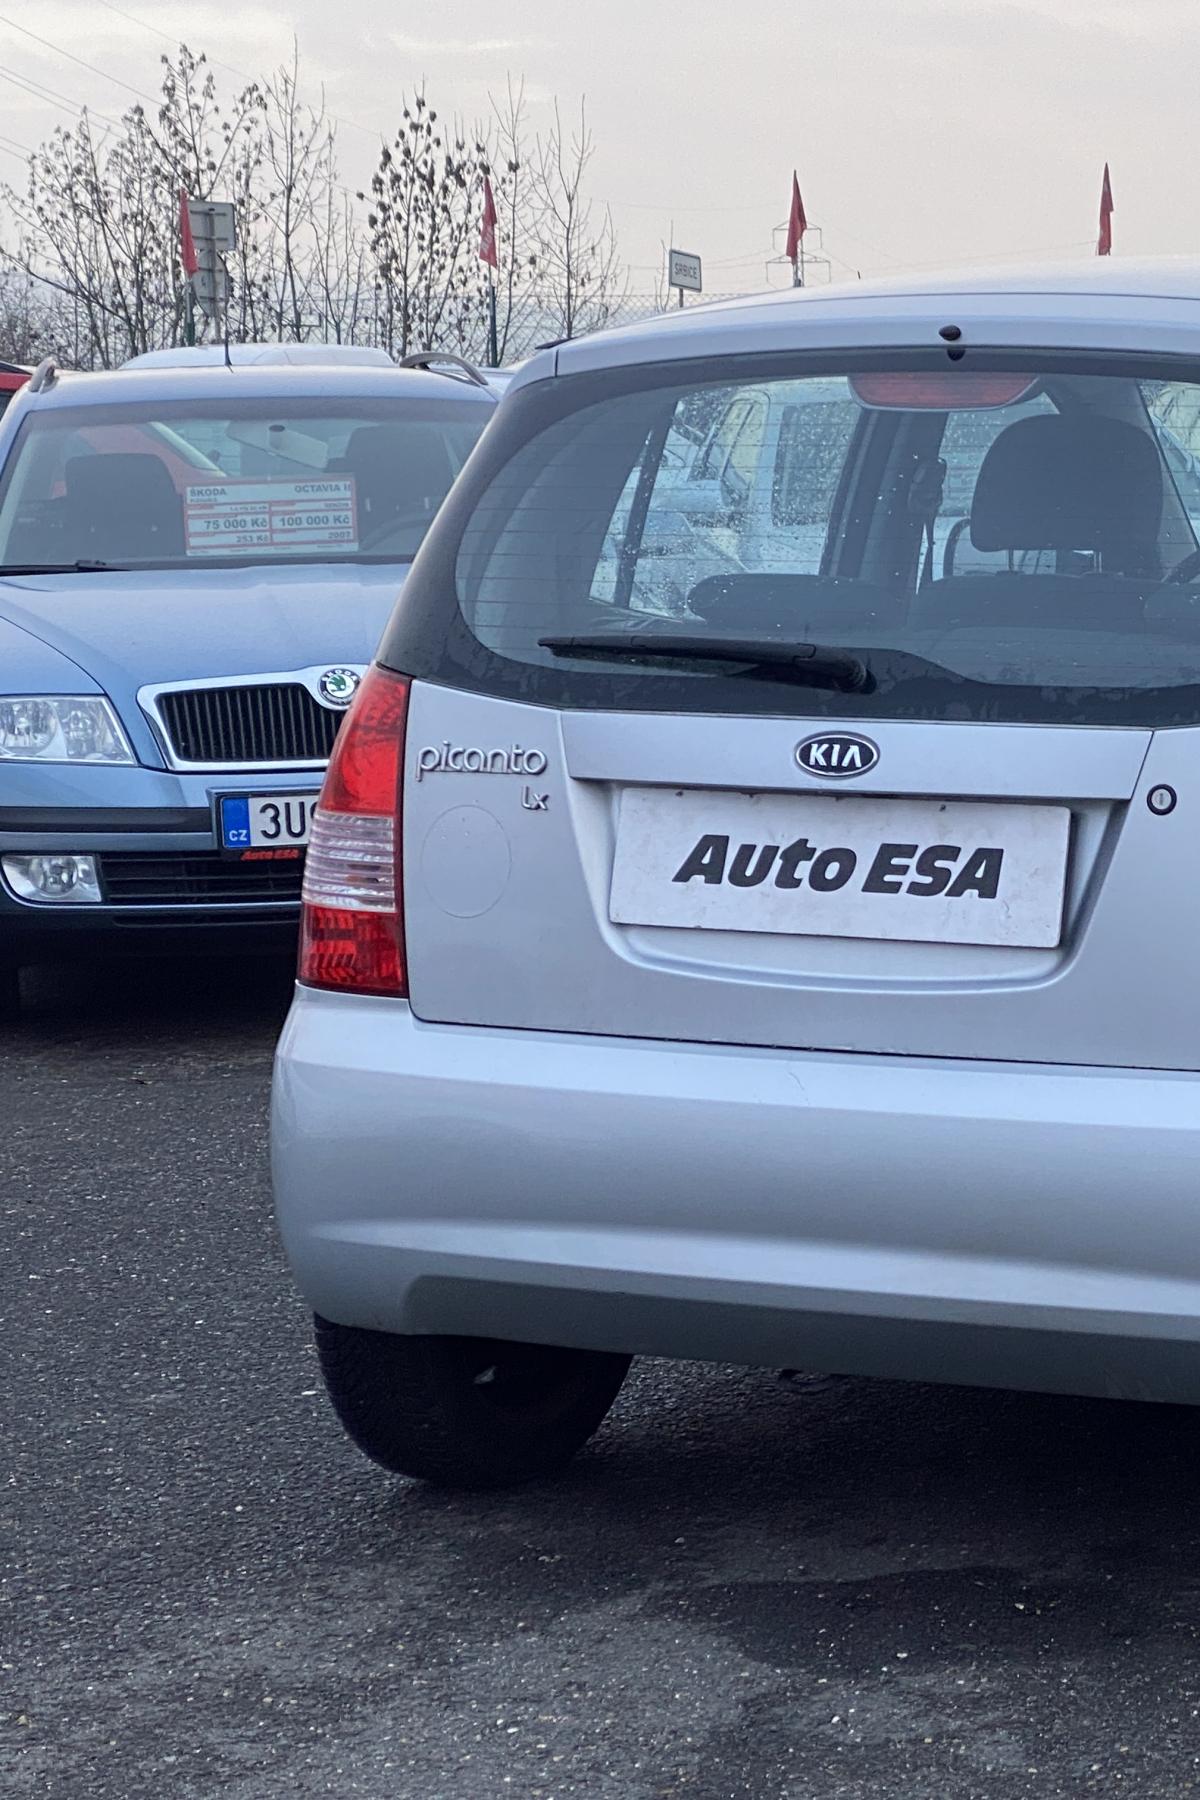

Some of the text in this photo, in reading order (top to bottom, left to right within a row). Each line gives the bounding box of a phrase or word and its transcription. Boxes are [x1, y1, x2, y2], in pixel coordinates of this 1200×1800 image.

[190, 487, 227, 498] ŠKODA
[294, 483, 340, 494] OCTAVIA
[204, 517, 268, 530] 75 000 Kč
[279, 514, 350, 527] 100 000 Kč
[416, 741, 548, 782] picanto
[809, 743, 862, 768] KIA
[228, 830, 248, 841] CZ
[671, 834, 1004, 899] Auto ESA
